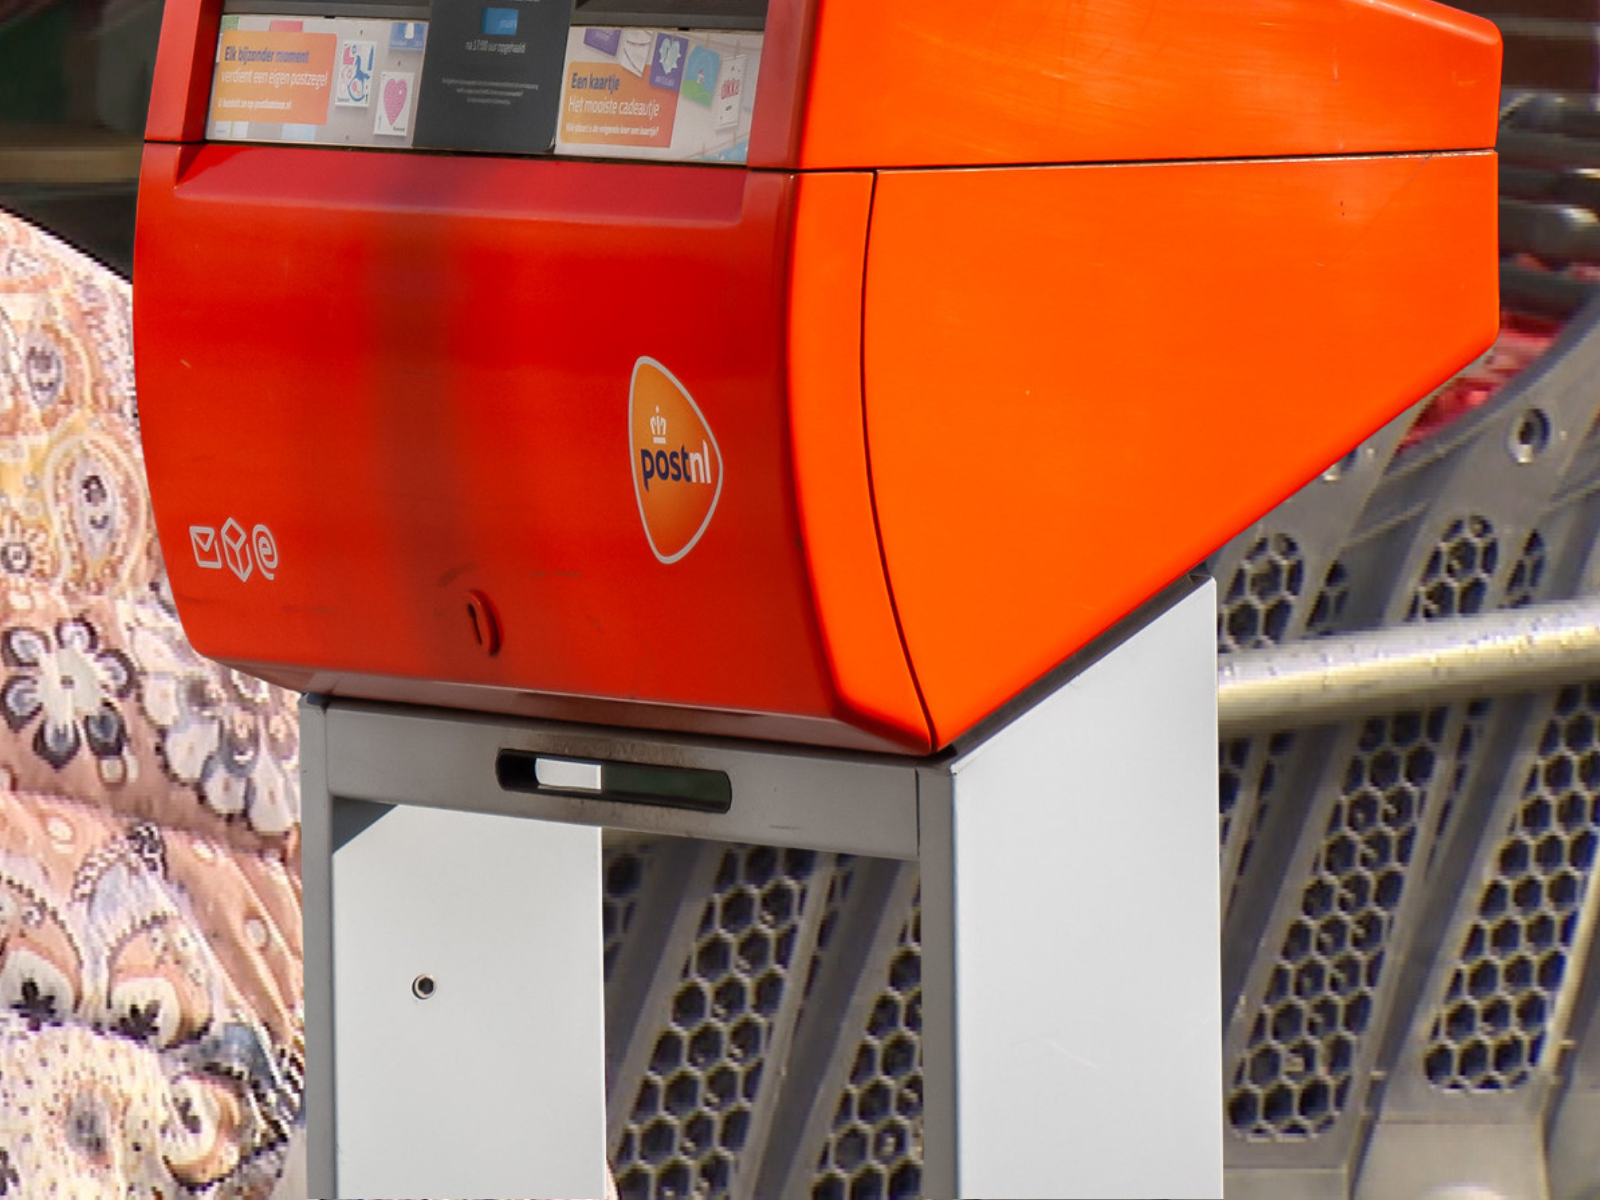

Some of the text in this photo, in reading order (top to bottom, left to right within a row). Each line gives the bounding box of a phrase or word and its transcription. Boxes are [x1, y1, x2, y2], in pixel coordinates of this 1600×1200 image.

[225, 46, 309, 66] Elk bijzonder moment
[221, 68, 328, 91] verdient een eigen postzegel
[571, 72, 620, 95] Een kaartje
[568, 96, 660, 120] Het mooiste cadeautje
[640, 439, 712, 492] postnl
